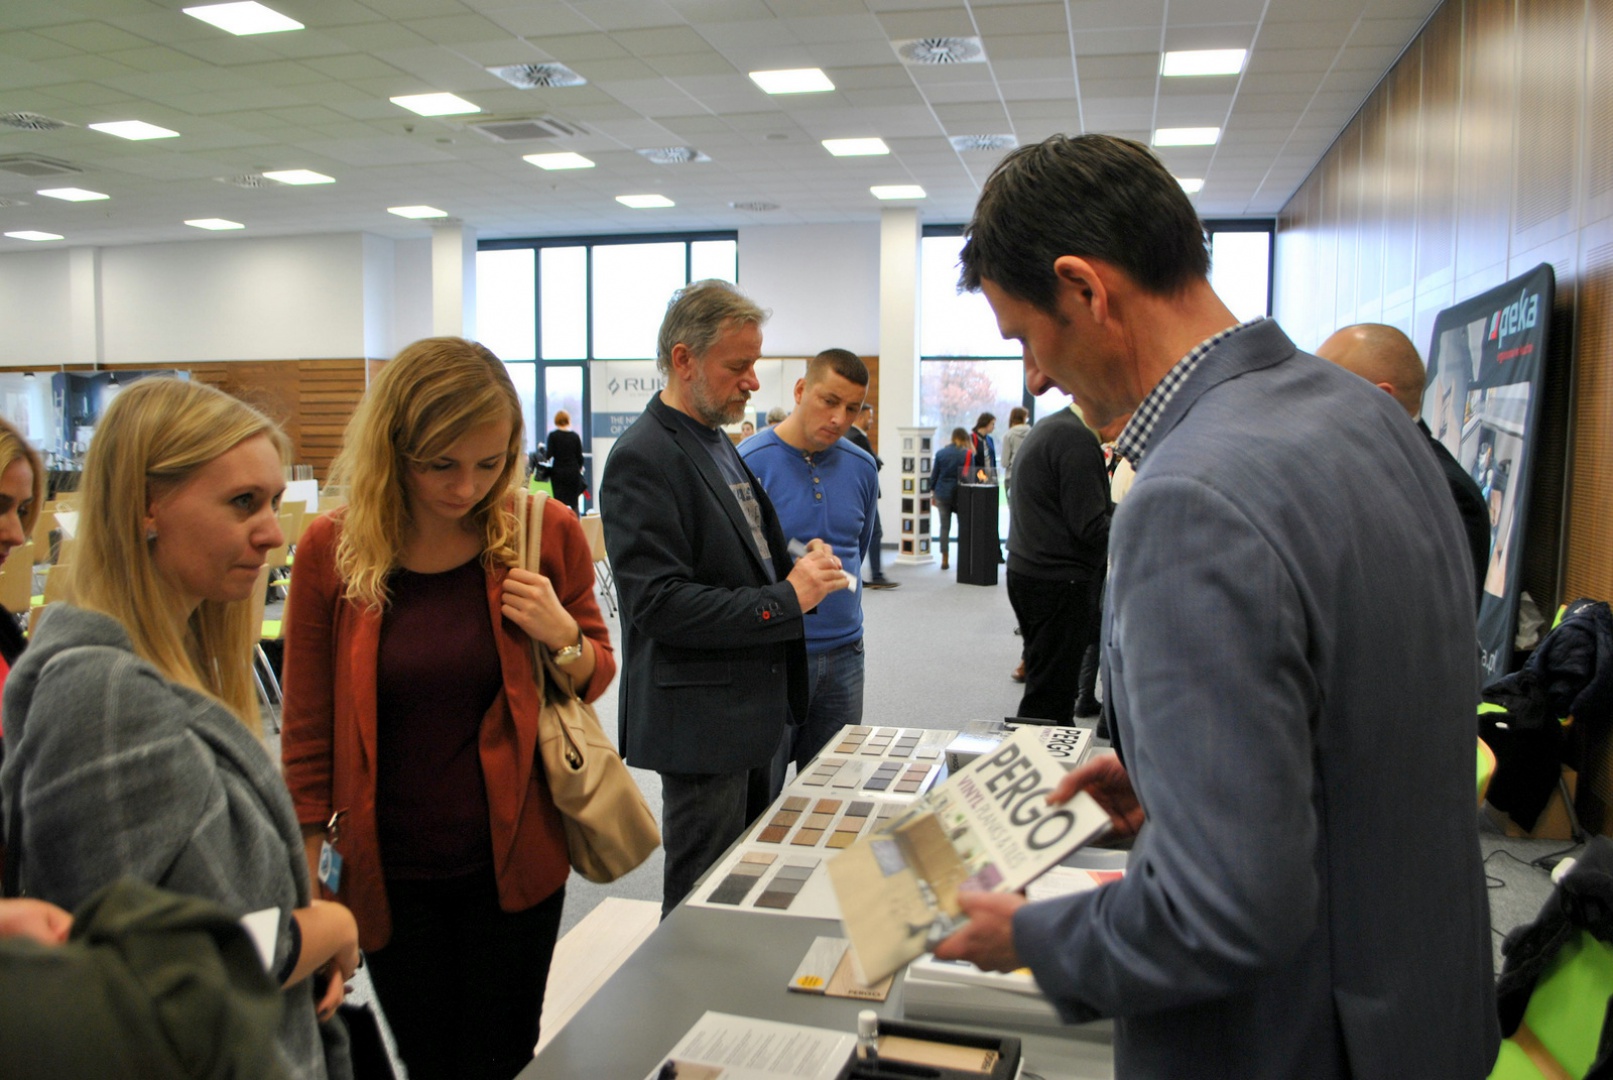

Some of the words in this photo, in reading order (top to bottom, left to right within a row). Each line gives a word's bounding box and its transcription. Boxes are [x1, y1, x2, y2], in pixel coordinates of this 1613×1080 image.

[1498, 287, 1539, 349] peka
[610, 415, 624, 425] THE
[1046, 728, 1082, 758] PERGO
[957, 774, 985, 810] VINYL
[975, 742, 1076, 851] PERGO
